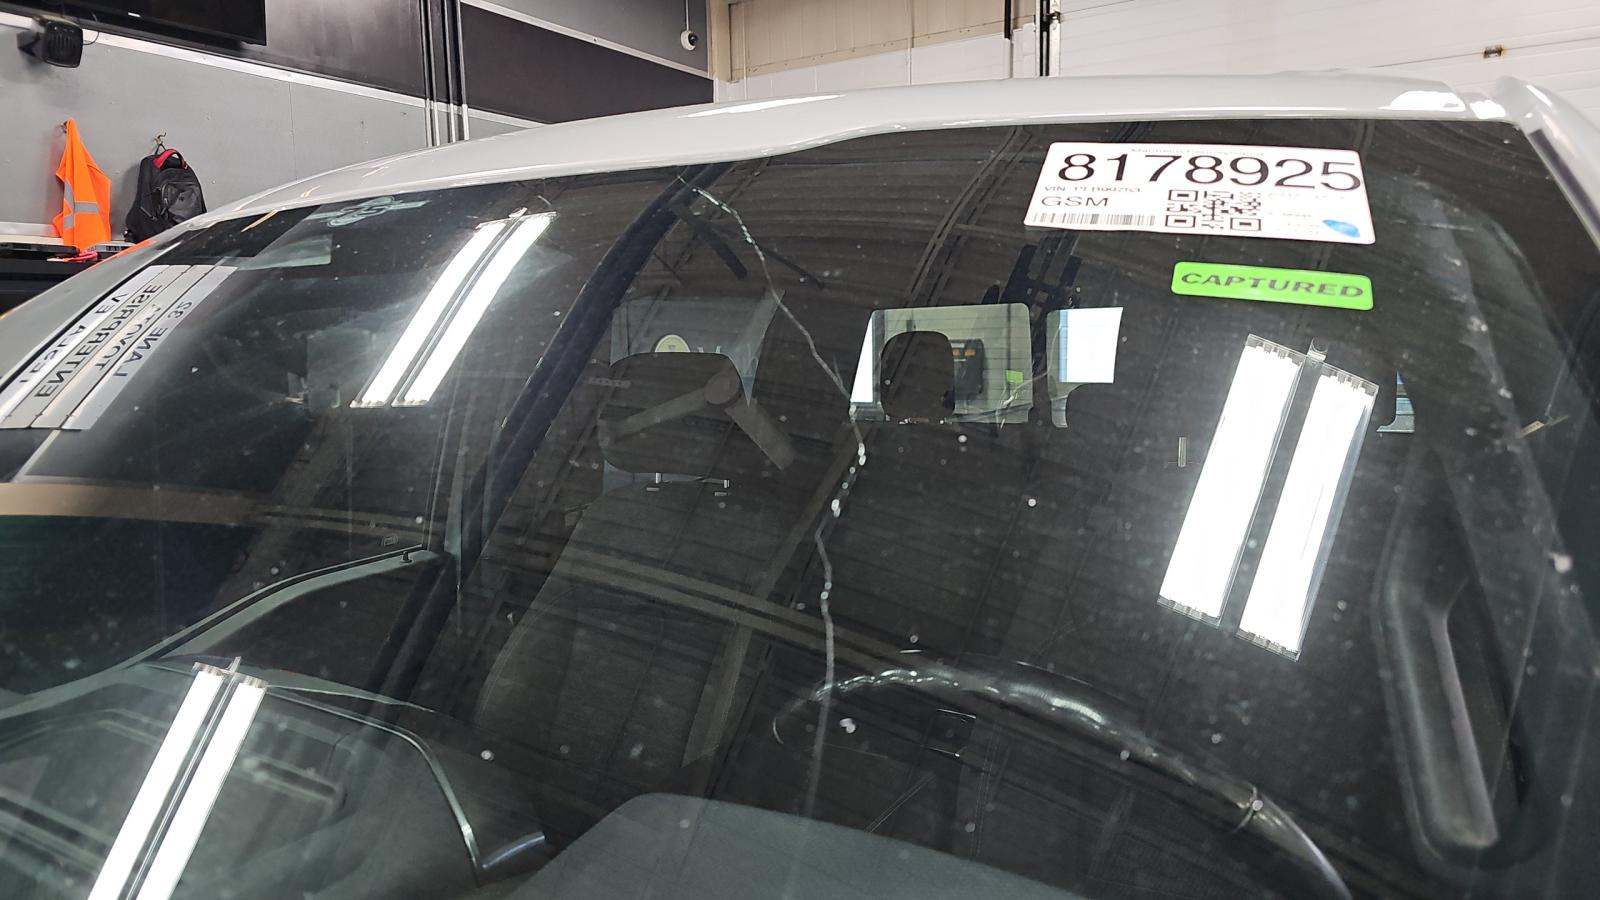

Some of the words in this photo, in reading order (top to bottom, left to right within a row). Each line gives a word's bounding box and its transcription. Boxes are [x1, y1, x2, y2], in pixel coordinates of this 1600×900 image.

[1058, 153, 1361, 191] 8178925
[1041, 196, 1109, 207] GSM
[1181, 273, 1364, 298] CAPTURED
